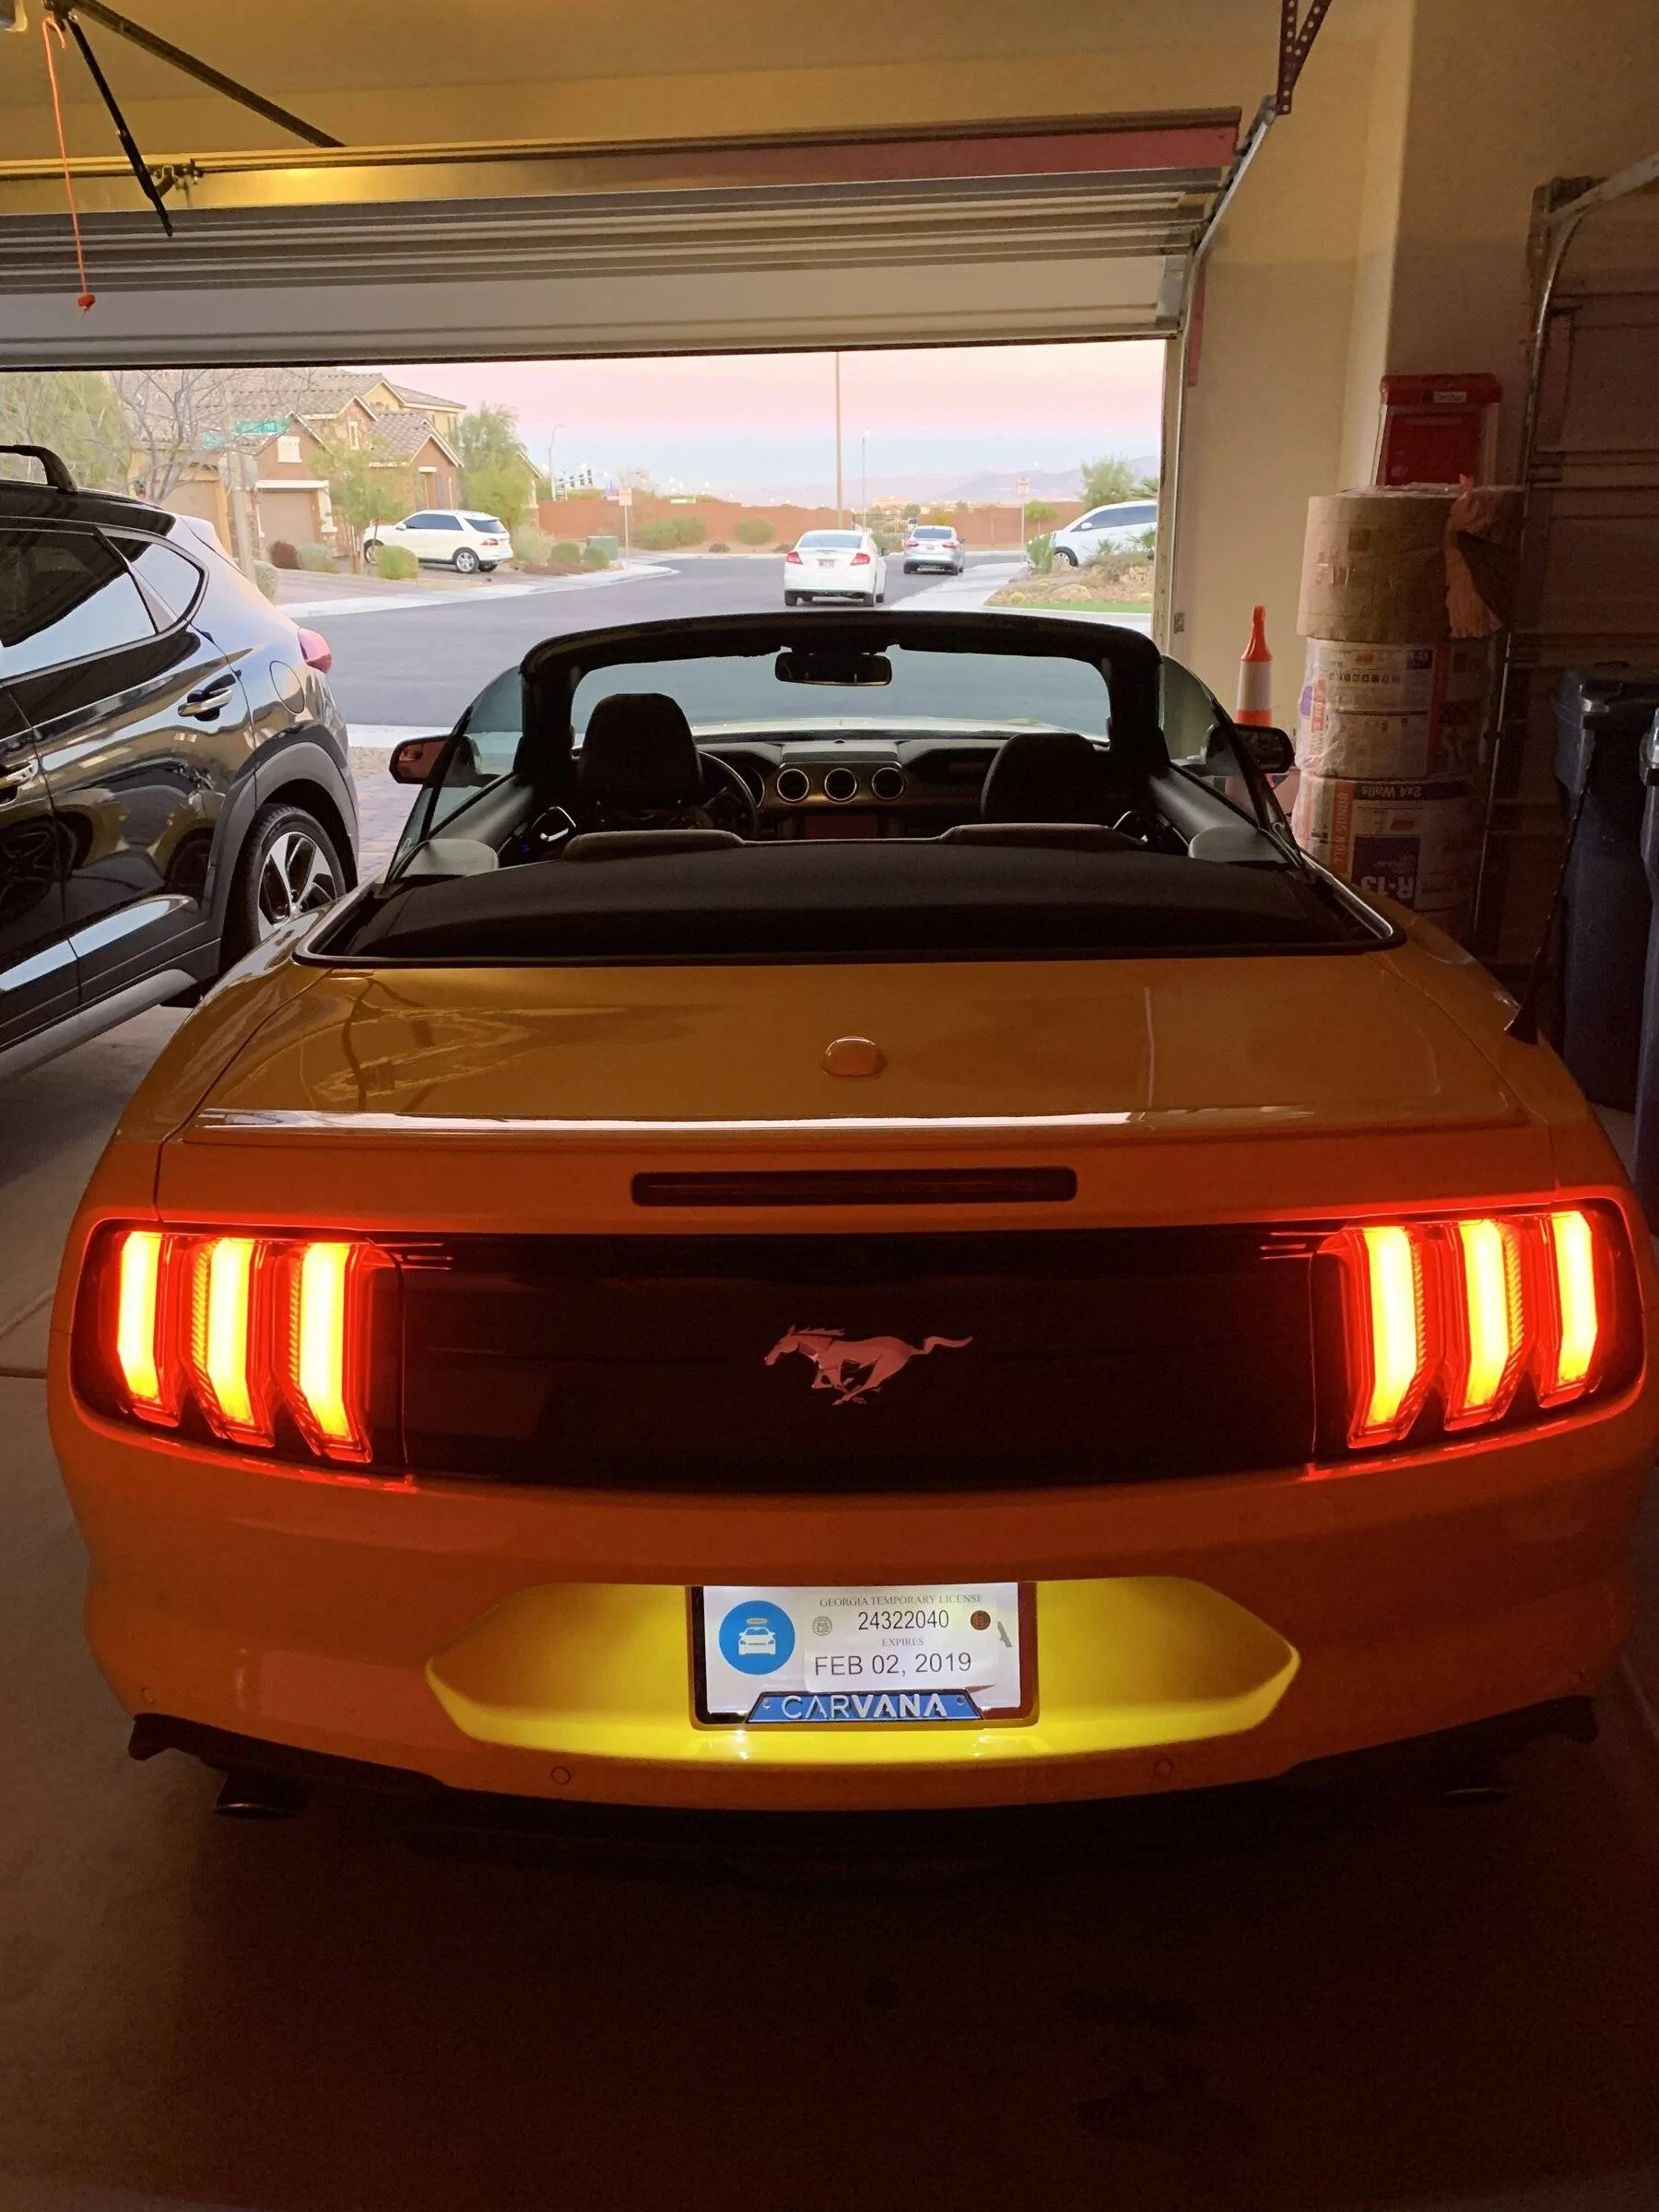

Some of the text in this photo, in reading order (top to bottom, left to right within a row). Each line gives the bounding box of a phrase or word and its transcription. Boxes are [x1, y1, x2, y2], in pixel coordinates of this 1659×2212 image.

[1360, 786, 1396, 798] Walls
[819, 1594, 982, 1607] GEORGIA TEMPORARY LICENSE
[858, 1609, 949, 1630] 24322040
[882, 1636, 924, 1647] EXPIRES
[815, 1652, 972, 1677] FEB 02, 2019
[781, 1694, 947, 1719] CARVANA
